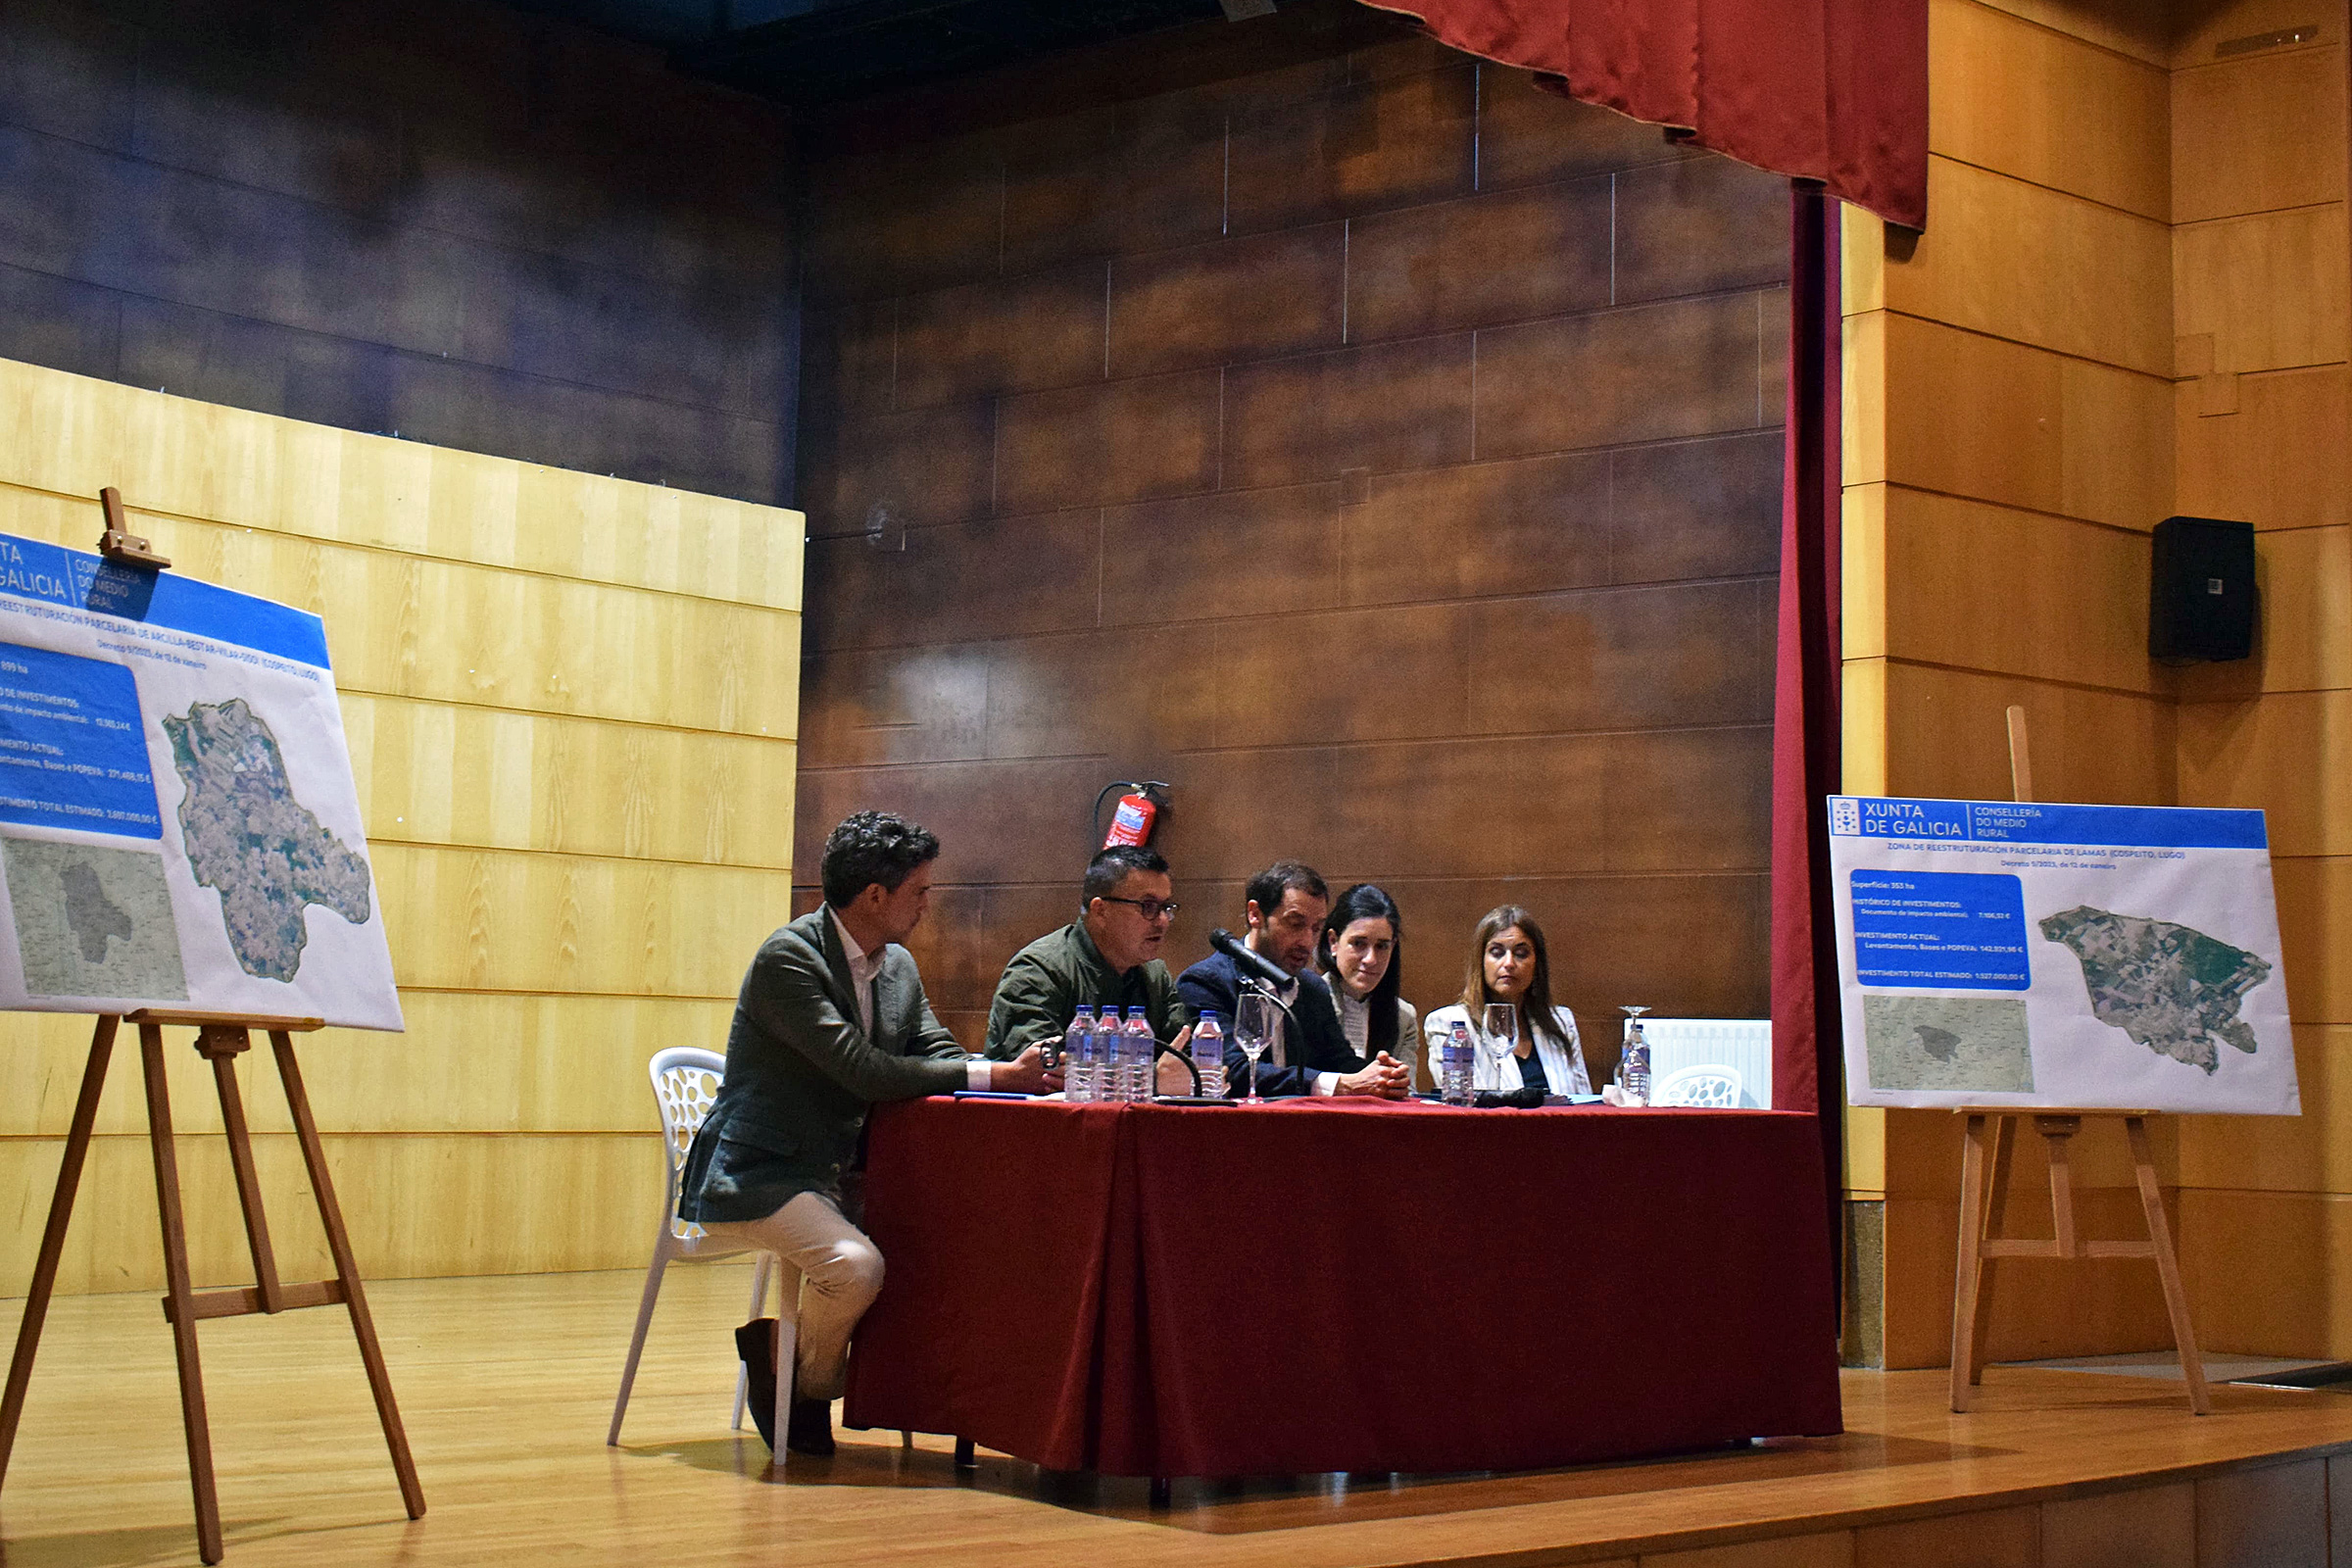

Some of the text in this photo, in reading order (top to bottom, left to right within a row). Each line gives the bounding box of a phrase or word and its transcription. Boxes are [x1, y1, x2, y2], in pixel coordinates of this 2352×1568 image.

[77, 574, 129, 598] DO MEDIO
[138, 628, 150, 639] DE
[1865, 803, 1925, 818] XUNTA
[1975, 806, 2042, 818] CONSELLERÍA
[1865, 819, 1963, 836] DE GALICIA
[1976, 817, 2028, 828] DO MEDIO
[1977, 828, 2010, 838] RURAL
[1887, 842, 1912, 851] ZONA
[1914, 843, 1925, 852] DE
[2010, 847, 2062, 856] PARCELARIA
[2077, 848, 2107, 857] LAMAS
